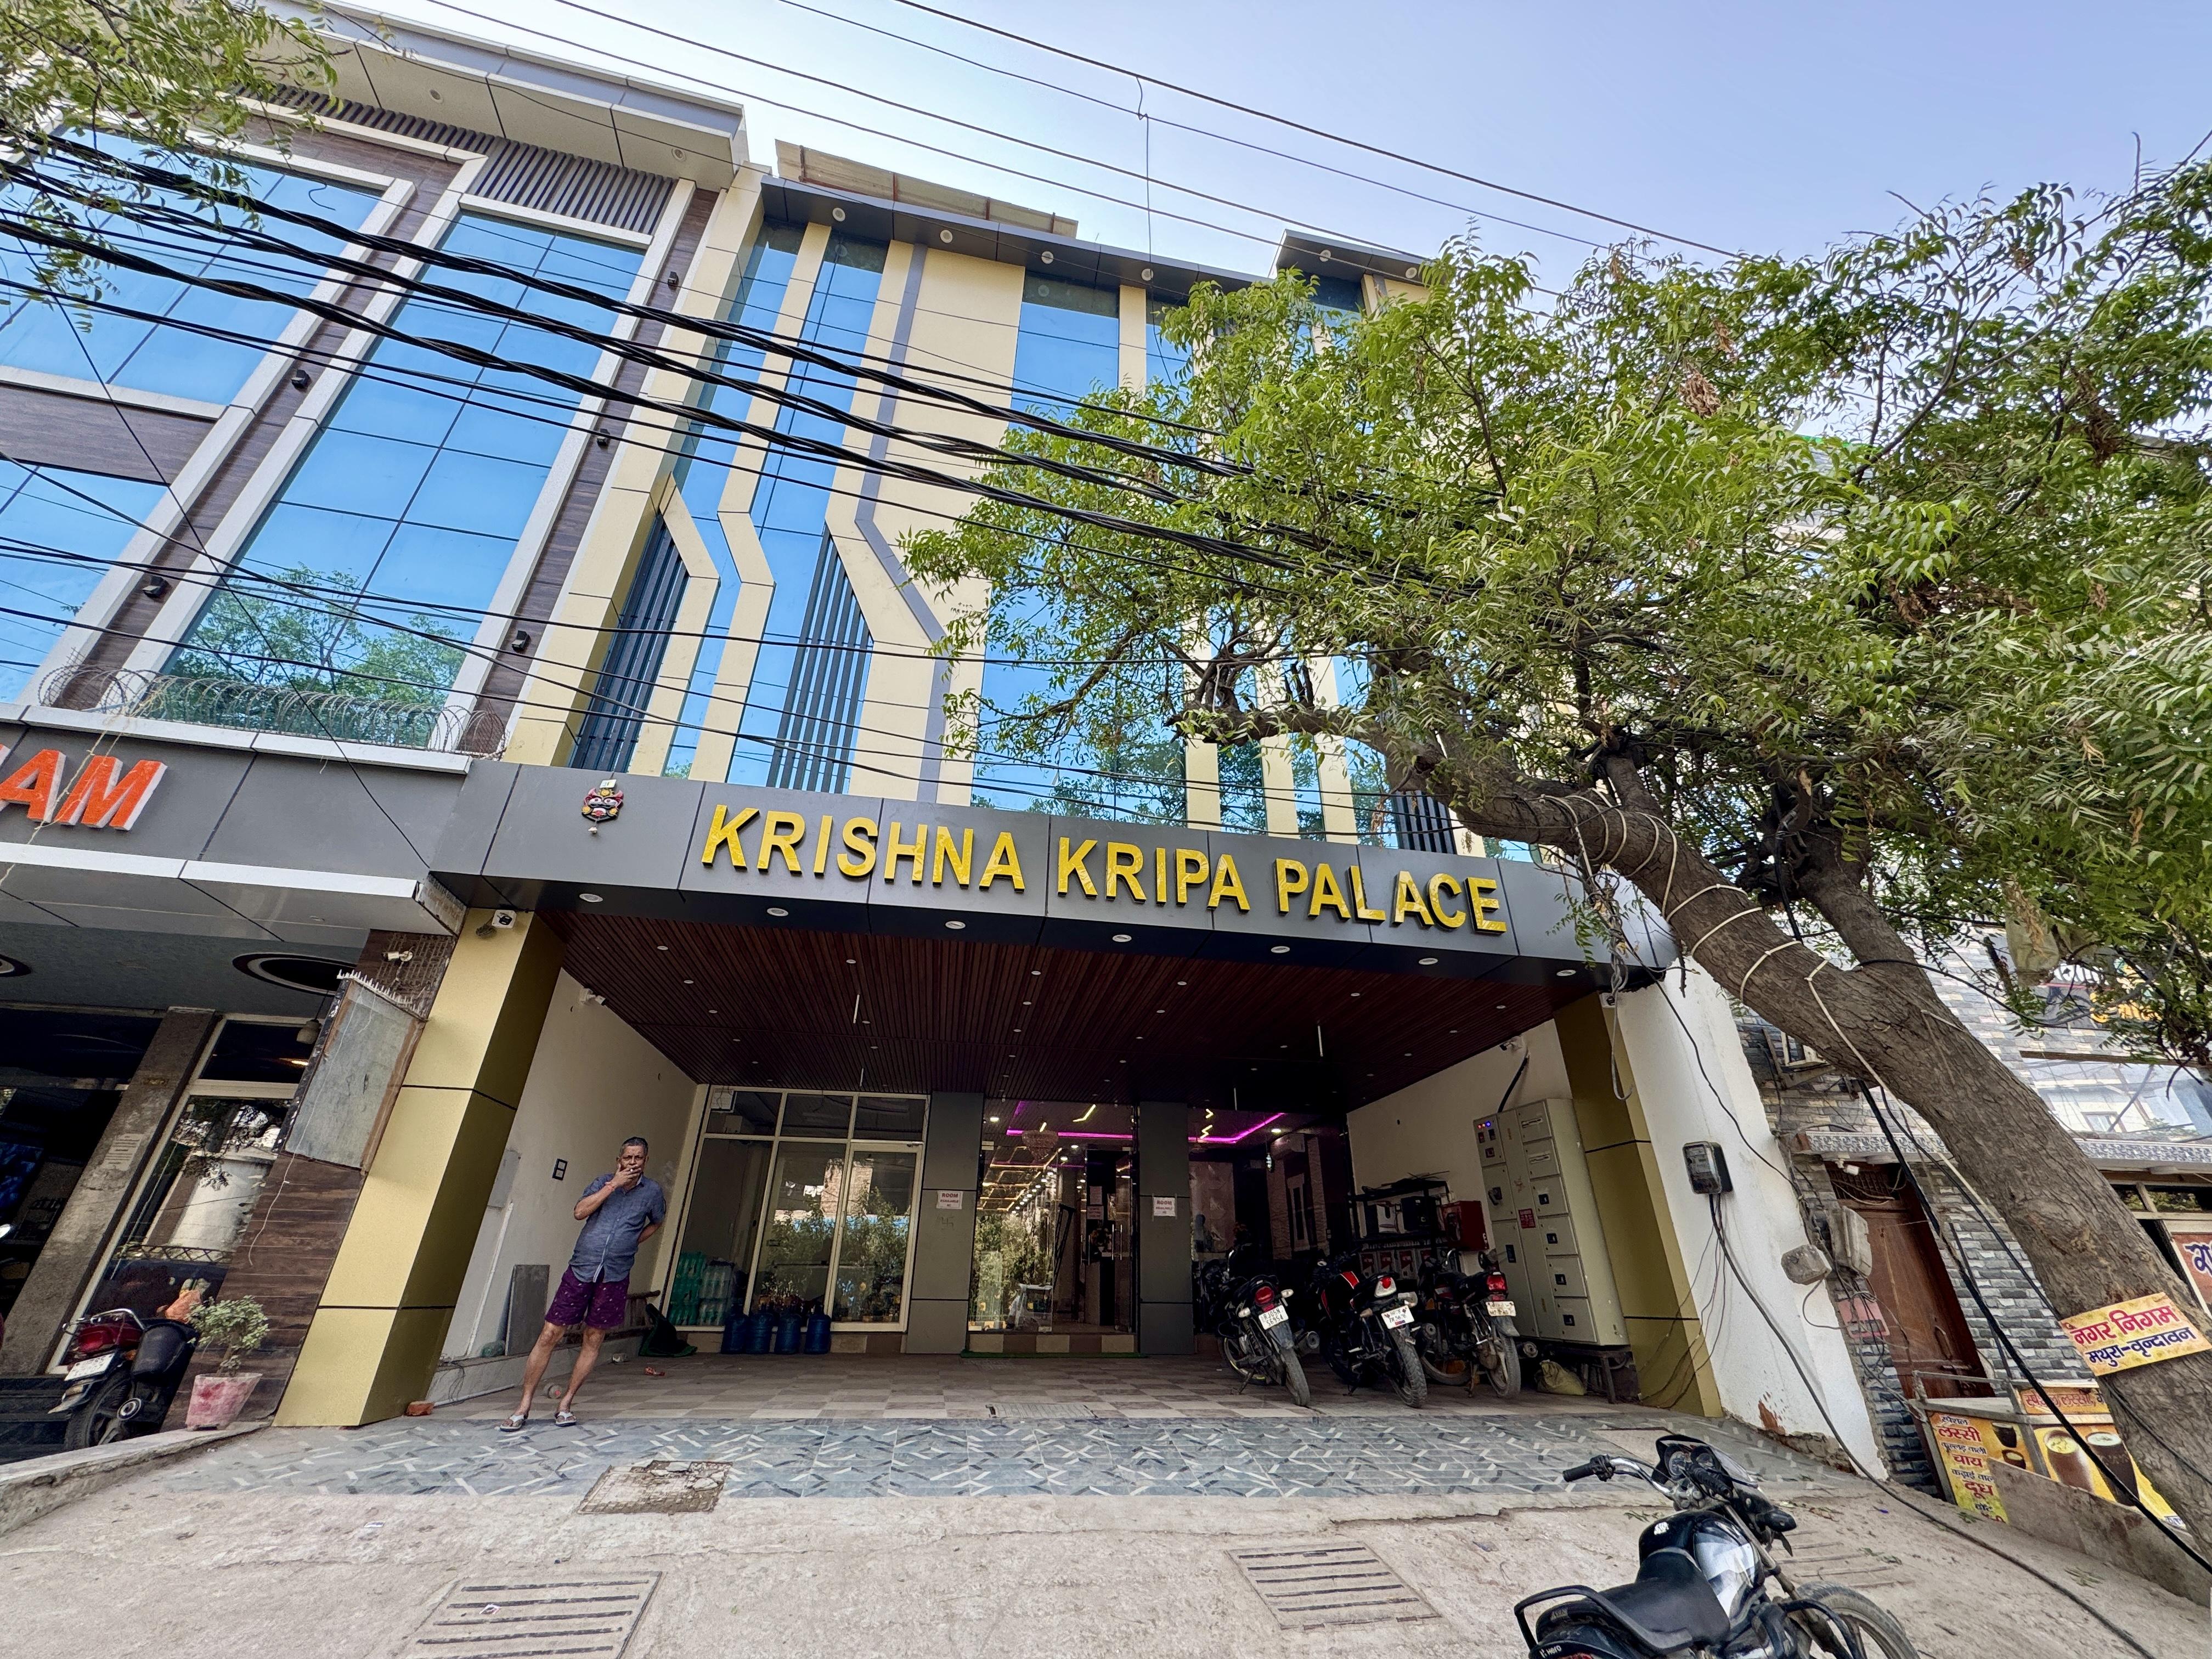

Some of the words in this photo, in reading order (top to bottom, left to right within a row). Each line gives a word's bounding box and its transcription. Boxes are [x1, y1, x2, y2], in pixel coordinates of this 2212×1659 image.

[0, 744, 168, 831] AM
[701, 804, 1025, 892] KRISHNA
[1057, 836, 1251, 913] KRIPA
[1274, 857, 1507, 935] PALACE
[2070, 1322, 2117, 1345] नगर
[2108, 1305, 2180, 1335] निगम
[1936, 1426, 1982, 1442] लस्सी
[1952, 1453, 1983, 1468] चाय
[1962, 1479, 1994, 1499] दूध
